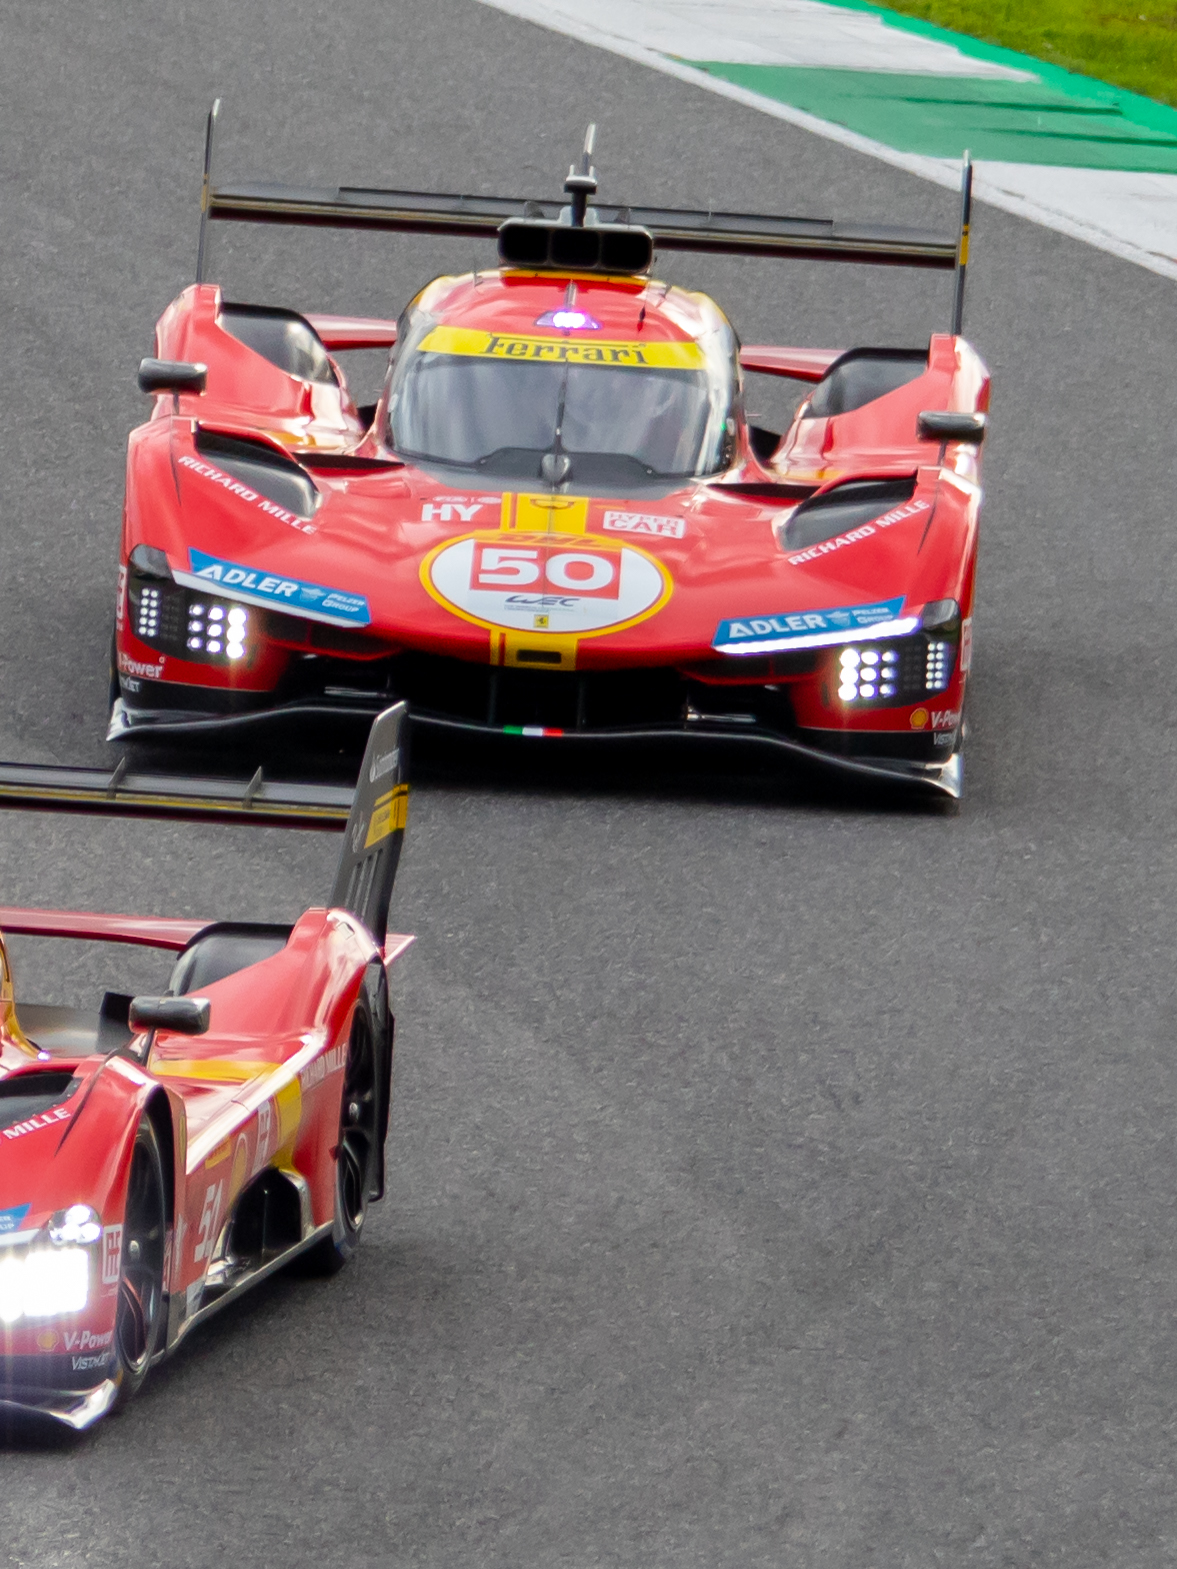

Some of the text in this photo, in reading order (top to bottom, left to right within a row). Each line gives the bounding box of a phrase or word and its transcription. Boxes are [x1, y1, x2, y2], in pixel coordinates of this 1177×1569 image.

[479, 332, 648, 364] Ferrari
[178, 455, 317, 535] RICHARD MILLE
[421, 503, 483, 522] HY
[609, 518, 677, 535] CAR
[610, 513, 678, 527] HYPER
[788, 500, 930, 566] RICHARD MILLE
[195, 564, 299, 598] ADLER
[478, 548, 613, 590] 50
[504, 594, 581, 607] WEC
[729, 613, 827, 639] ADLER
[3, 1108, 71, 1140] MILLE
